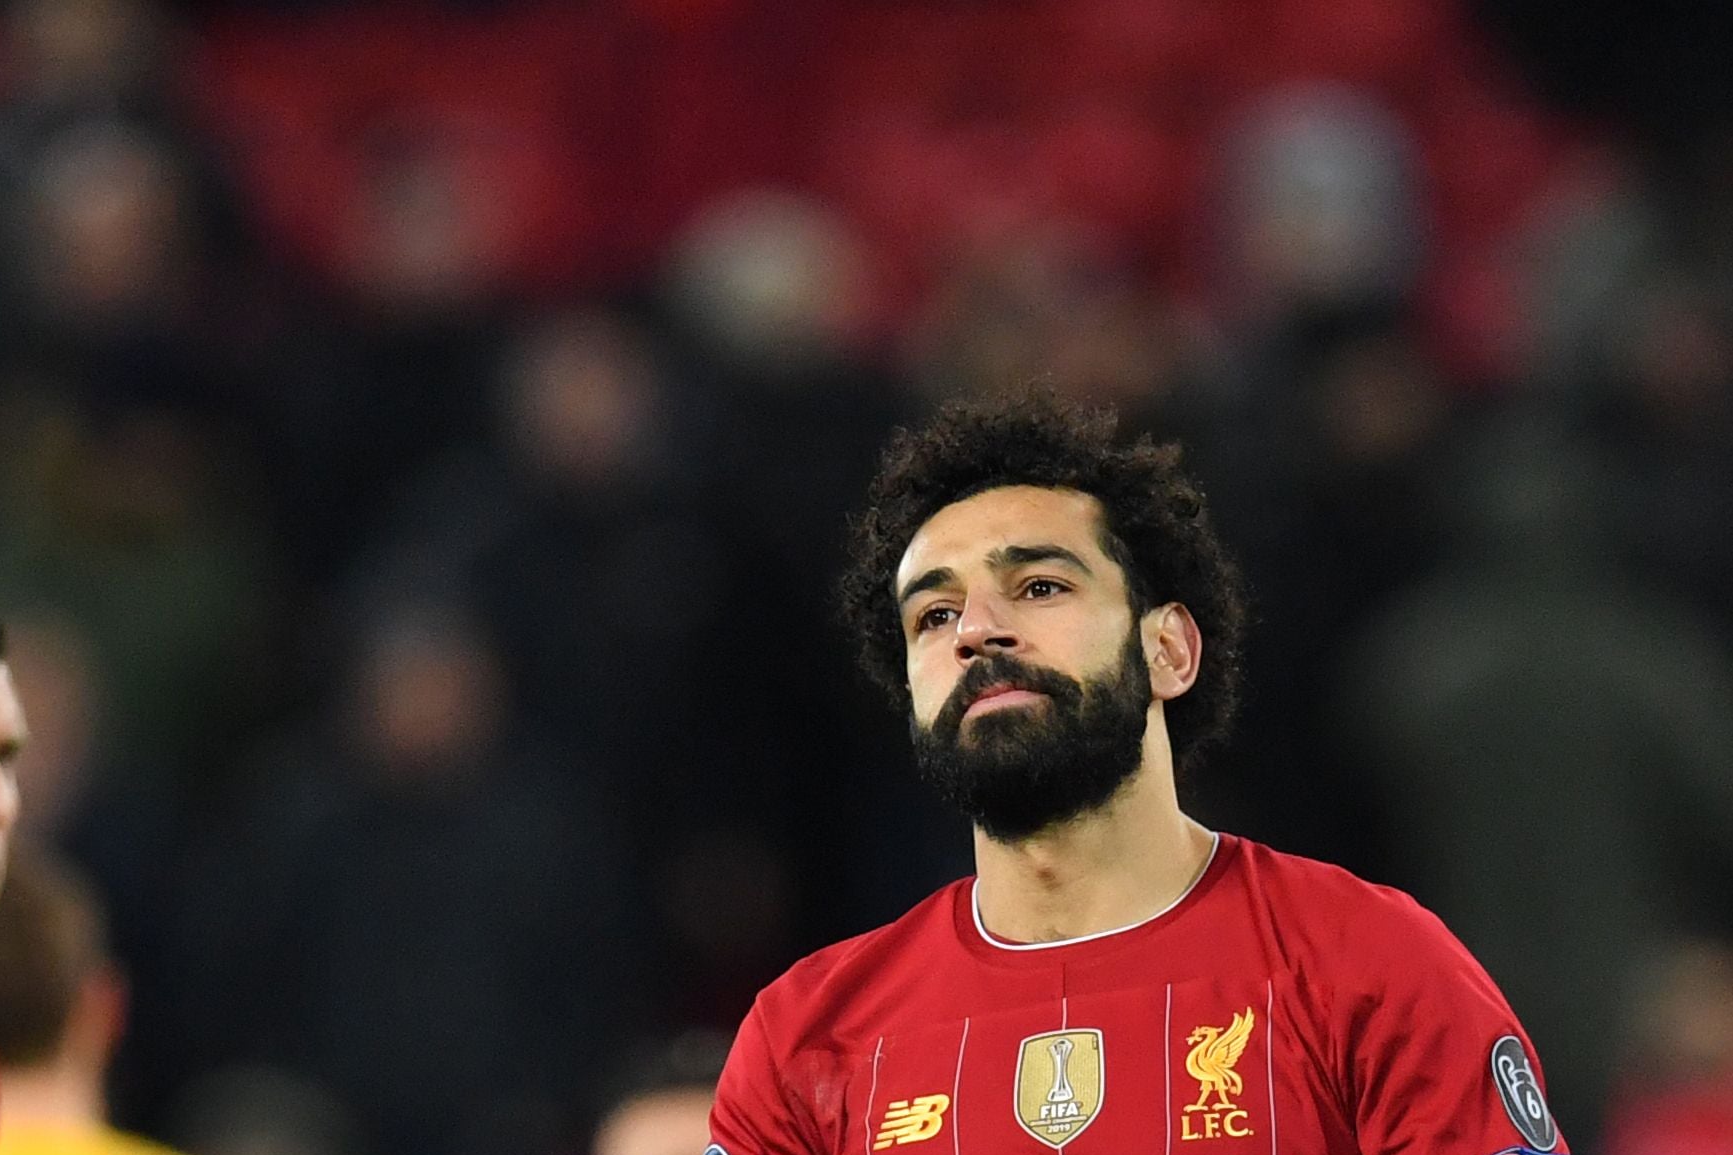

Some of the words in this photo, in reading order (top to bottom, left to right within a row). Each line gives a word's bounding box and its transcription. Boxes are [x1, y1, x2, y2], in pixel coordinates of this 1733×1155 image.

[1040, 1102, 1079, 1120] FIFA
[1526, 1090, 1542, 1120] 6
[1047, 1123, 1071, 1134] 2019
